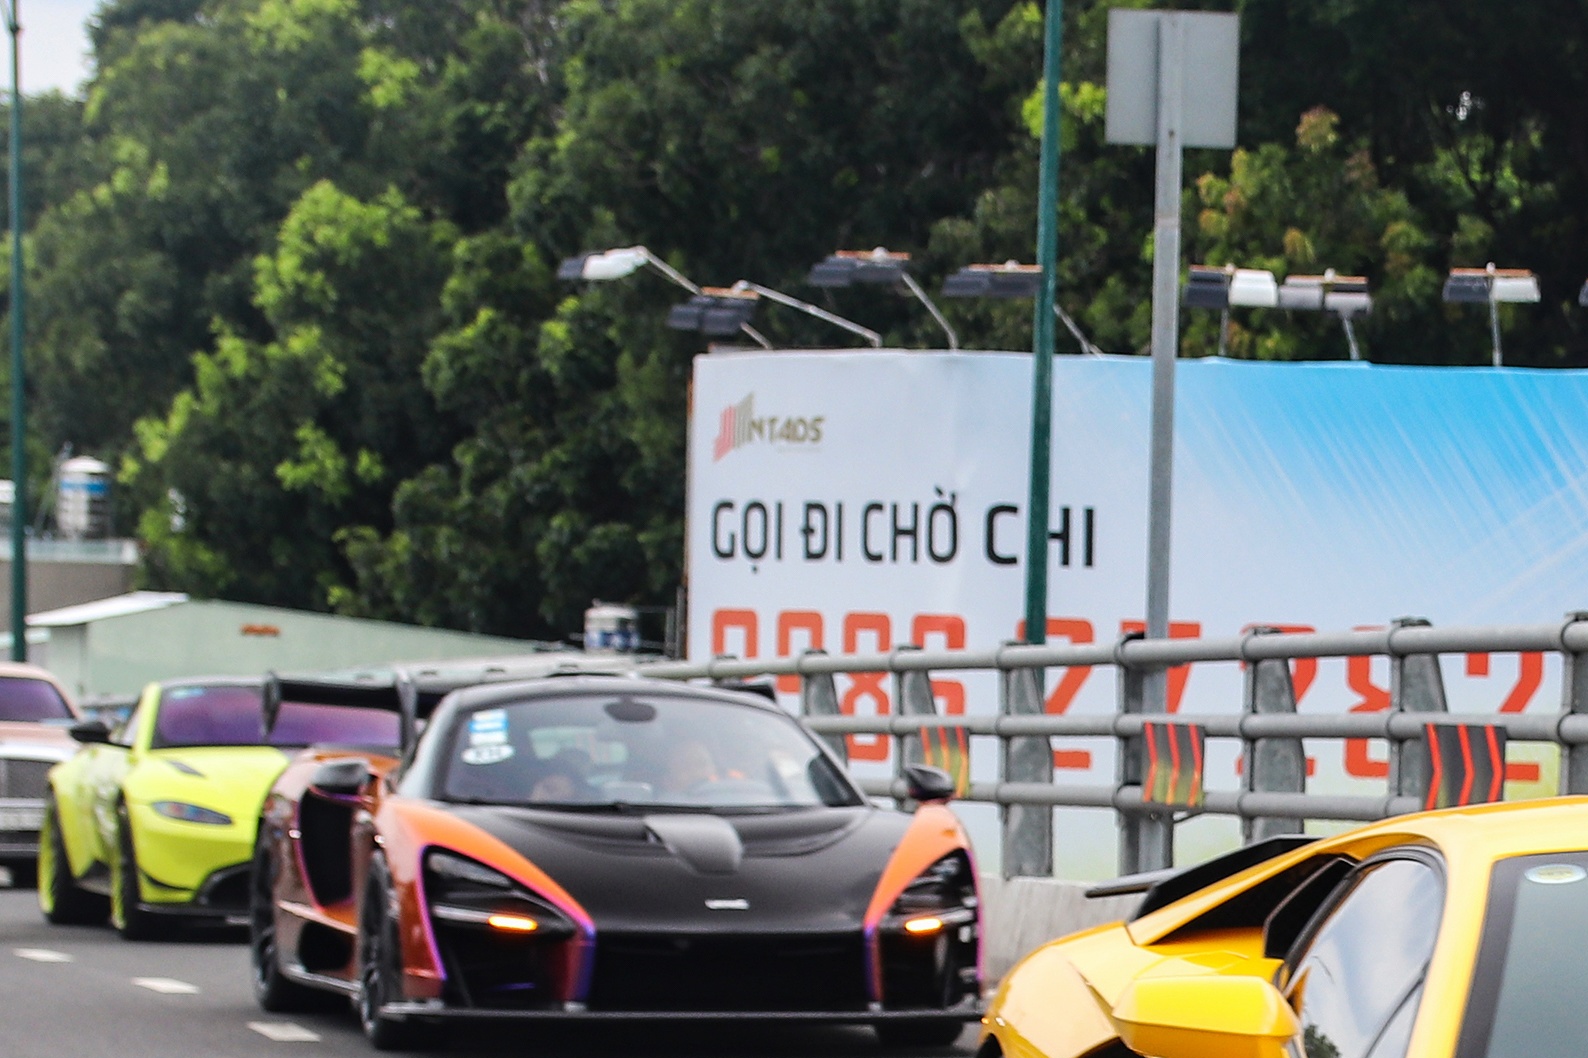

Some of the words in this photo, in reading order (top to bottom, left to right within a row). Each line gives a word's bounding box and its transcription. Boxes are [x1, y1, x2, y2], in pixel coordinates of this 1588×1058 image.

[712, 501, 783, 574] GỌI
[800, 501, 843, 562] ĐI
[862, 485, 958, 564] CHỜ
